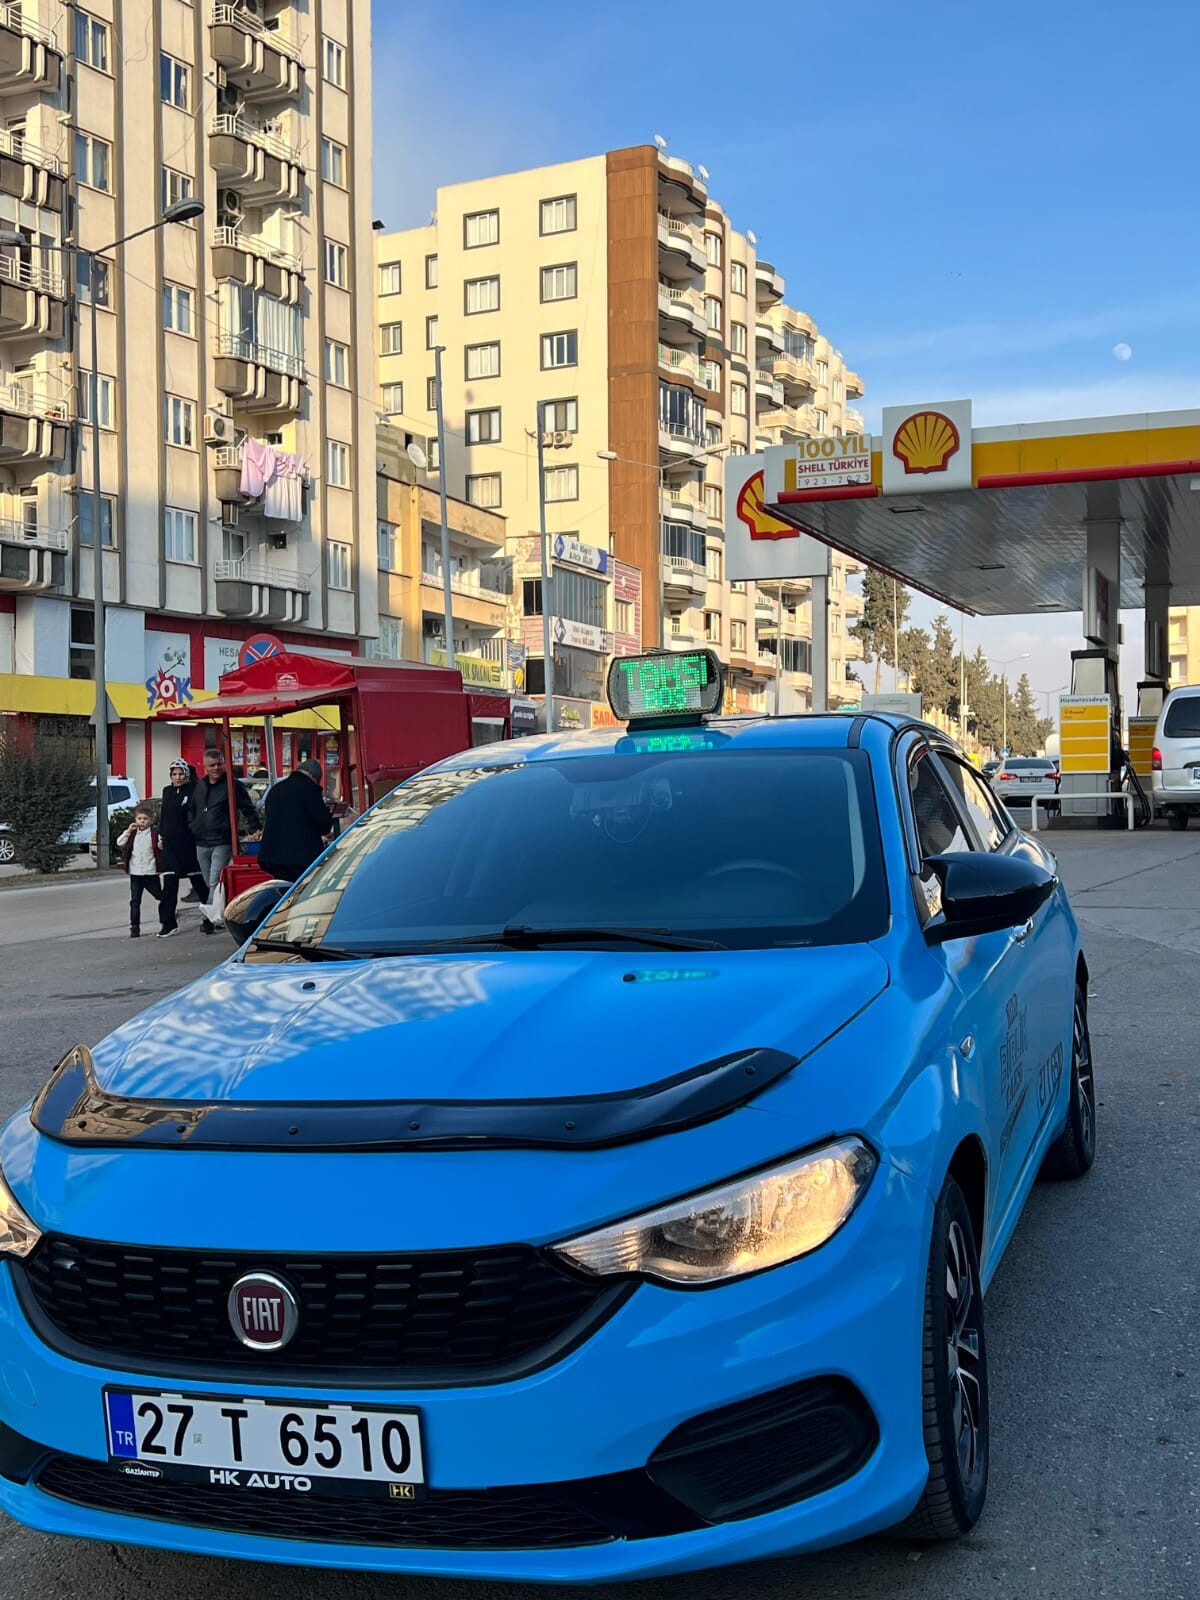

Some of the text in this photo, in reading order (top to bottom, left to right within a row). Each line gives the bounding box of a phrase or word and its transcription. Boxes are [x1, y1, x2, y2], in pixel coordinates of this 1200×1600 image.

[798, 436, 869, 459] 100 YIL
[798, 457, 869, 474] SHELL TÜRKİYE
[243, 1296, 280, 1331] FIAT
[116, 1430, 133, 1446] TR
[138, 1402, 411, 1474] 27 T 6510
[209, 1470, 312, 1491] HK AUTO
